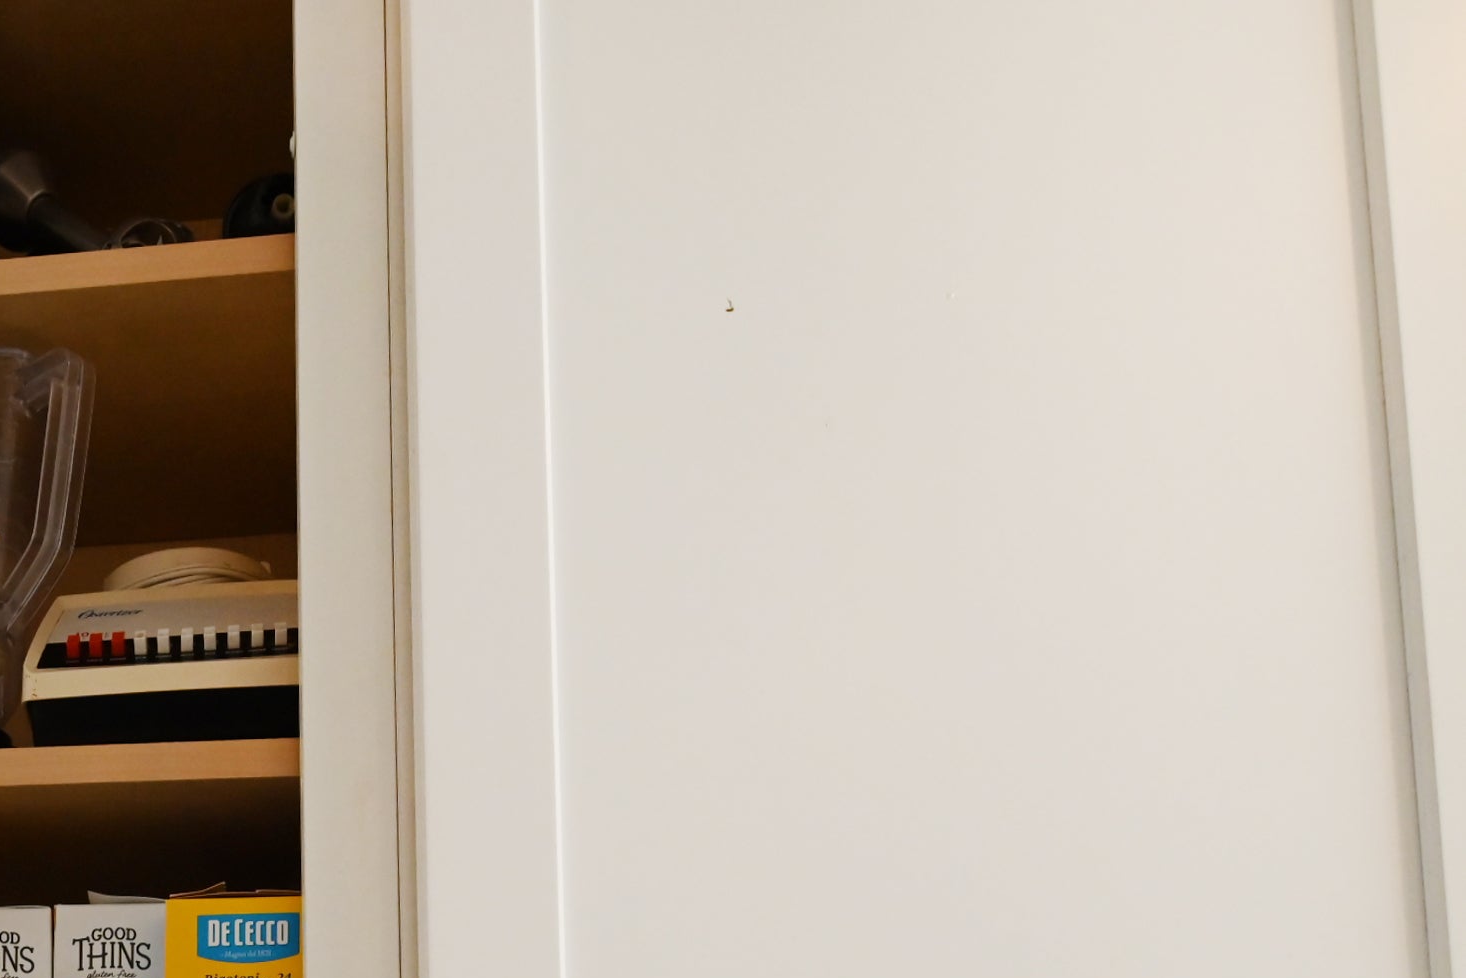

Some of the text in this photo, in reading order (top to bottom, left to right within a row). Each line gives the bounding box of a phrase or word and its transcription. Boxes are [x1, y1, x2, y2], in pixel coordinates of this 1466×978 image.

[91, 927, 137, 941] GOOD
[72, 936, 151, 971] THINS
[116, 969, 137, 978] free
